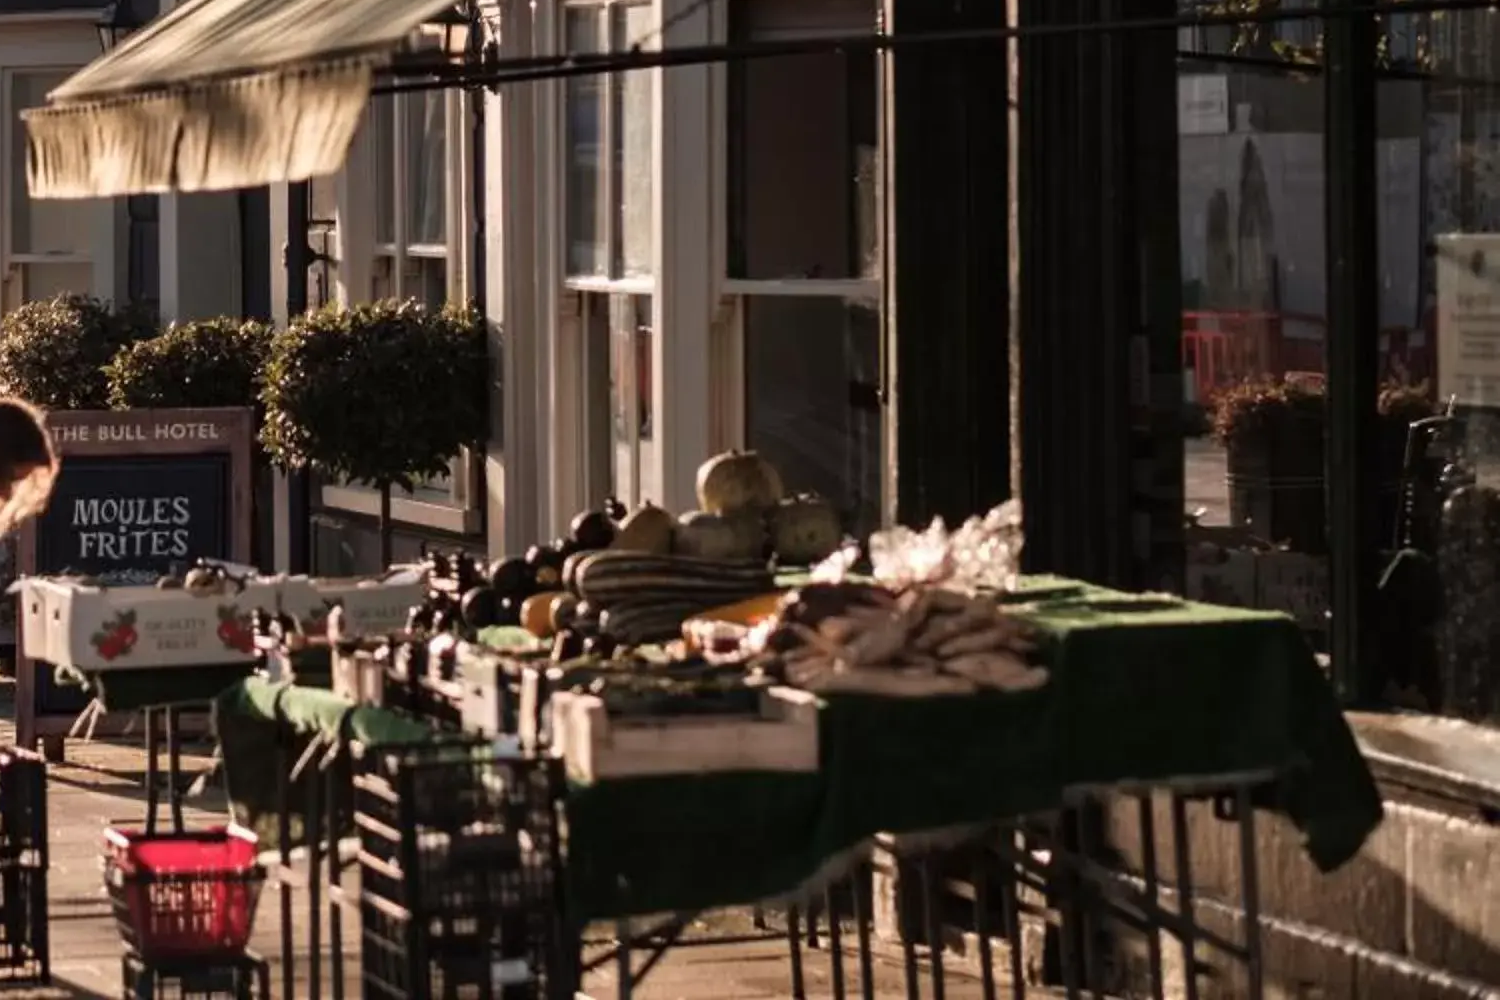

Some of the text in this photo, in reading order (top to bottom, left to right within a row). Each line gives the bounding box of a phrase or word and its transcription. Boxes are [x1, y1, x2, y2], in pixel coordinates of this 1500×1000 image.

[52, 423, 219, 442] THE BULL HOTEL
[73, 496, 190, 525] MOULES
